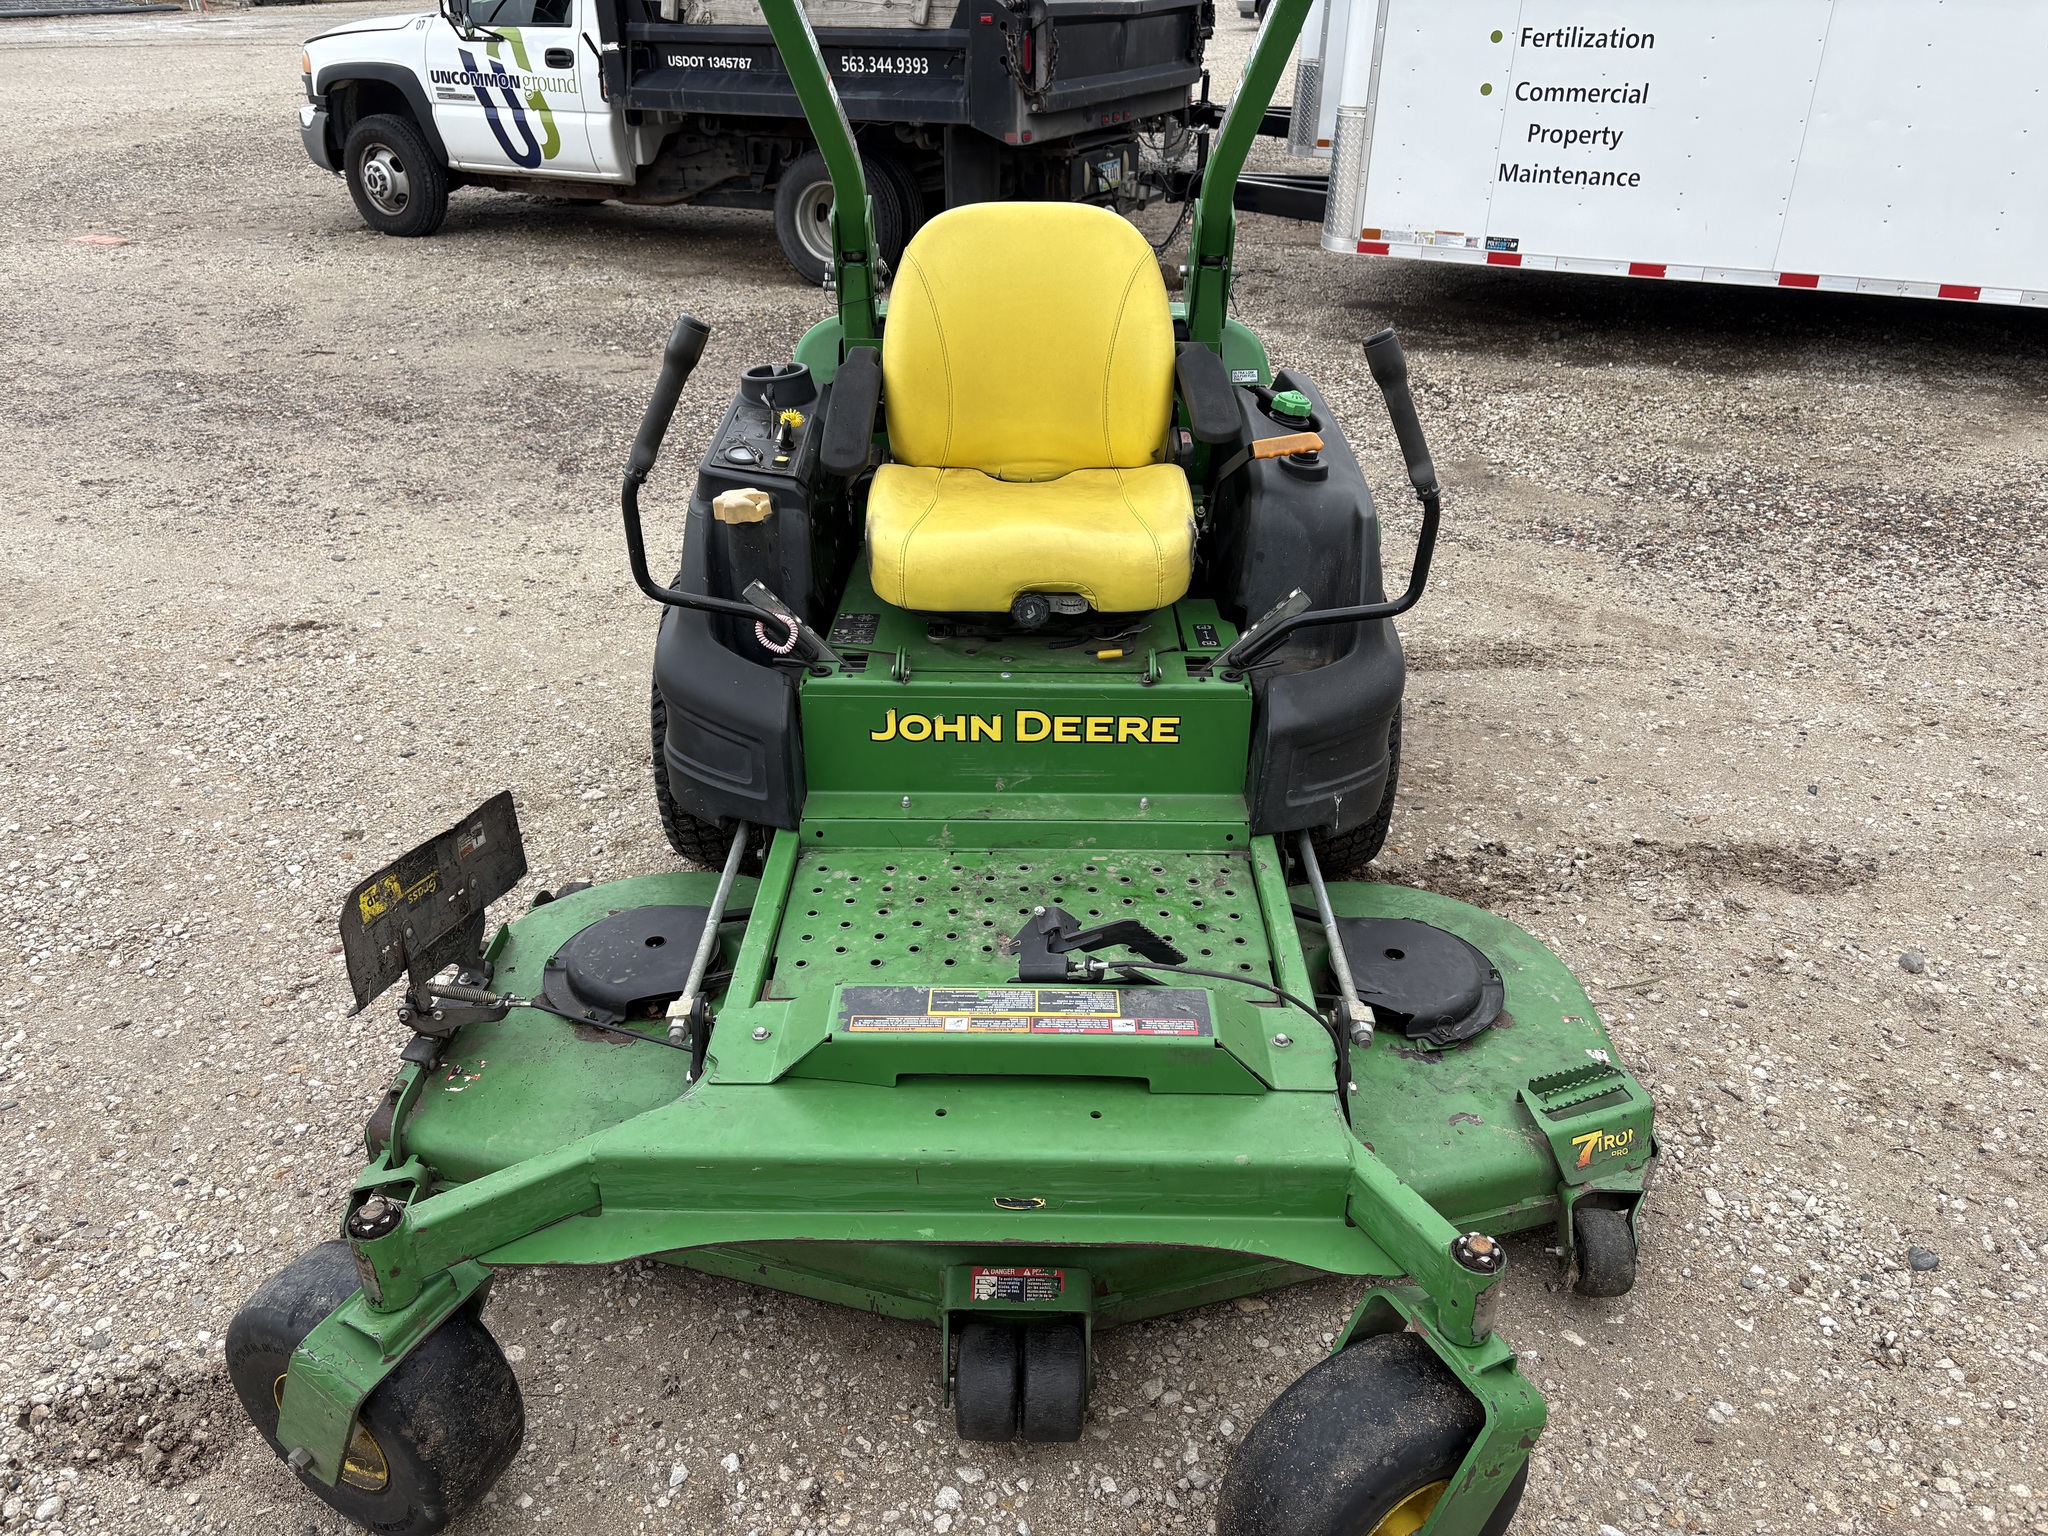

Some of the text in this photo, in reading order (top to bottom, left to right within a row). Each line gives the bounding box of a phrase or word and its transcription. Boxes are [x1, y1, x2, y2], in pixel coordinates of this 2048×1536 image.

[416, 20, 426, 31] 07
[1520, 26, 1655, 49] Fertilization
[667, 55, 752, 69] USDOT 1345787
[841, 55, 929, 74] 563.344.9393
[430, 69, 579, 99] UNCOMMON ground
[1515, 81, 1650, 104] Commercial
[1527, 123, 1624, 151] Property
[1498, 163, 1641, 187] Maintenance
[870, 707, 1182, 744] JOHN DEERE
[1611, 1147, 1629, 1157] PRO
